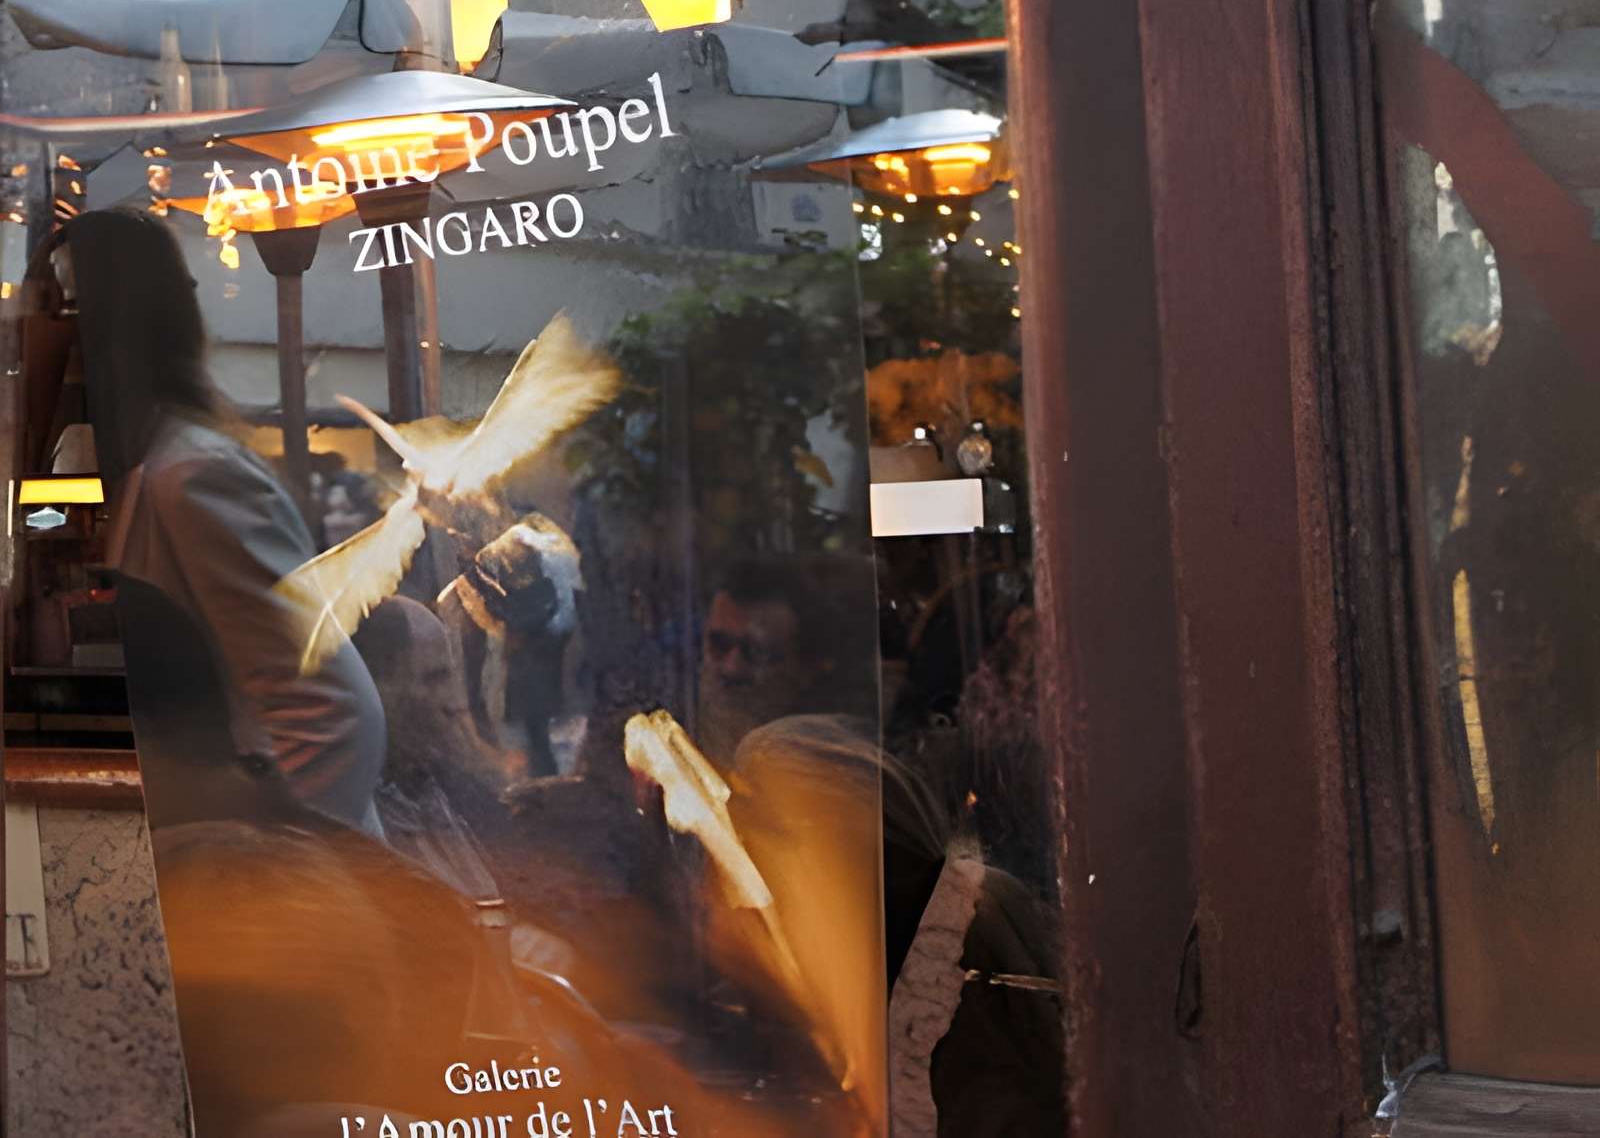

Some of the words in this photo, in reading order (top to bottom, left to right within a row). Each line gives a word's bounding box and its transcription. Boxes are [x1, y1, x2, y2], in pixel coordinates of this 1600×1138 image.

[203, 140, 441, 223] Antoine
[463, 72, 676, 173] Poupel
[348, 193, 584, 272] ZINGARO
[444, 1056, 562, 1094] Galerie
[526, 1101, 574, 1138] de
[583, 1098, 678, 1136] l'Art
